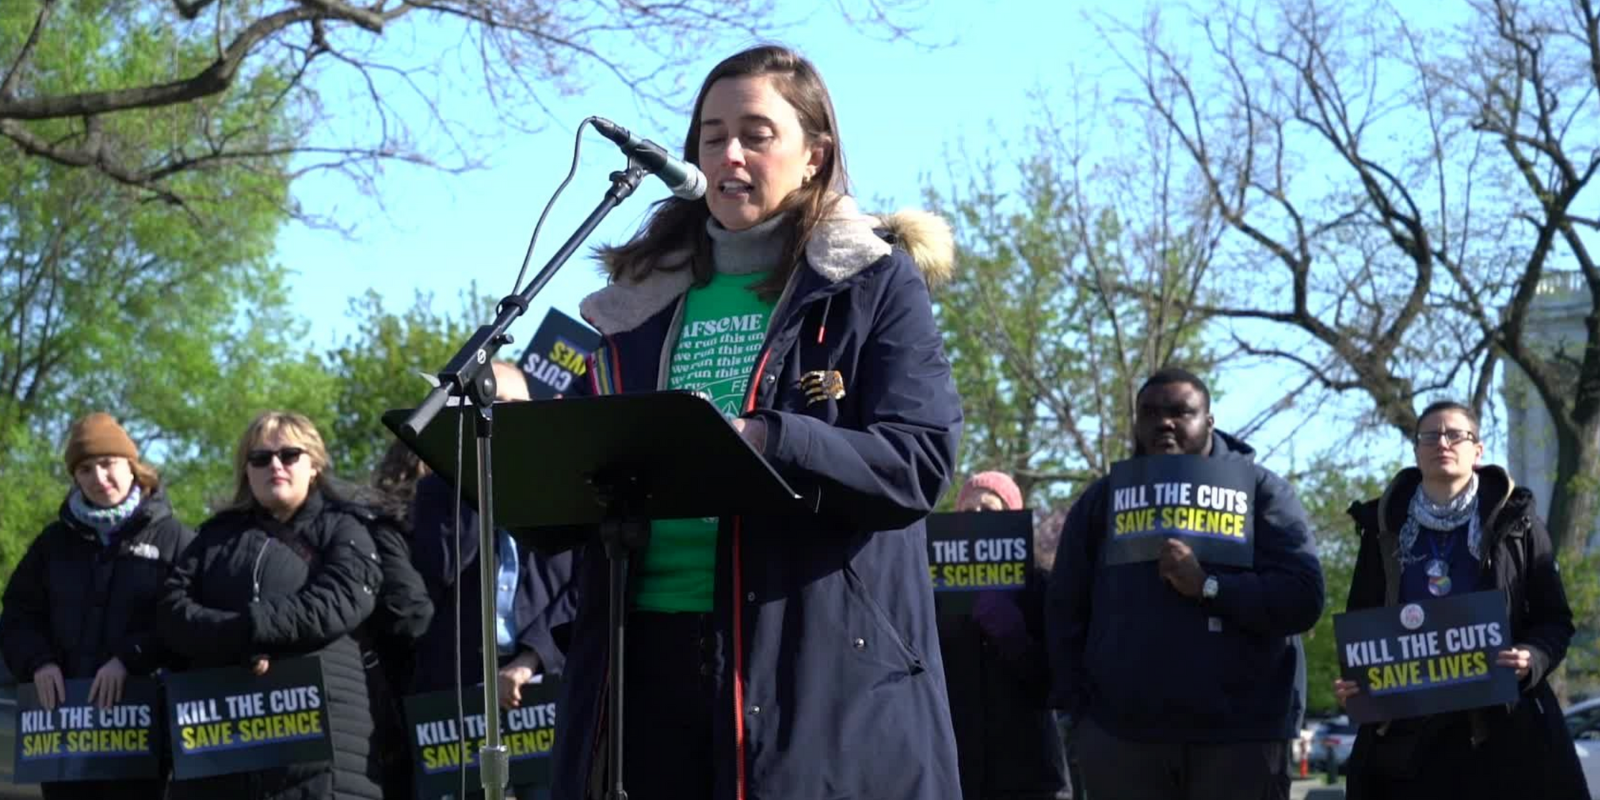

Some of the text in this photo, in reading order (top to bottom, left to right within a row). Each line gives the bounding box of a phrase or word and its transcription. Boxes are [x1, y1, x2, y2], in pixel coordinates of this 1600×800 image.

[694, 348, 715, 360] run
[719, 345, 743, 355] this
[695, 338, 717, 349] run
[720, 333, 745, 343] this
[523, 353, 572, 392] CUTS
[688, 371, 712, 380] run
[716, 368, 740, 378] this
[718, 356, 741, 367] this
[1114, 482, 1248, 514] KILL THE CUTS
[1115, 507, 1245, 538] SAVE SCIENCE
[932, 537, 1027, 563] THE CUTS
[942, 562, 1026, 587] SCIENCE
[1345, 621, 1502, 668] KILL THE CUTS
[1367, 651, 1488, 691] SAVE LIVES
[21, 704, 152, 733] KILL THE CUTS
[176, 685, 320, 725] KILL THE CUTS
[182, 711, 322, 749] SAVE SCIENCE
[415, 703, 556, 746] KILL TH CUTS
[23, 729, 149, 757] SAVE SCIENCE
[423, 741, 474, 769] SAVE
